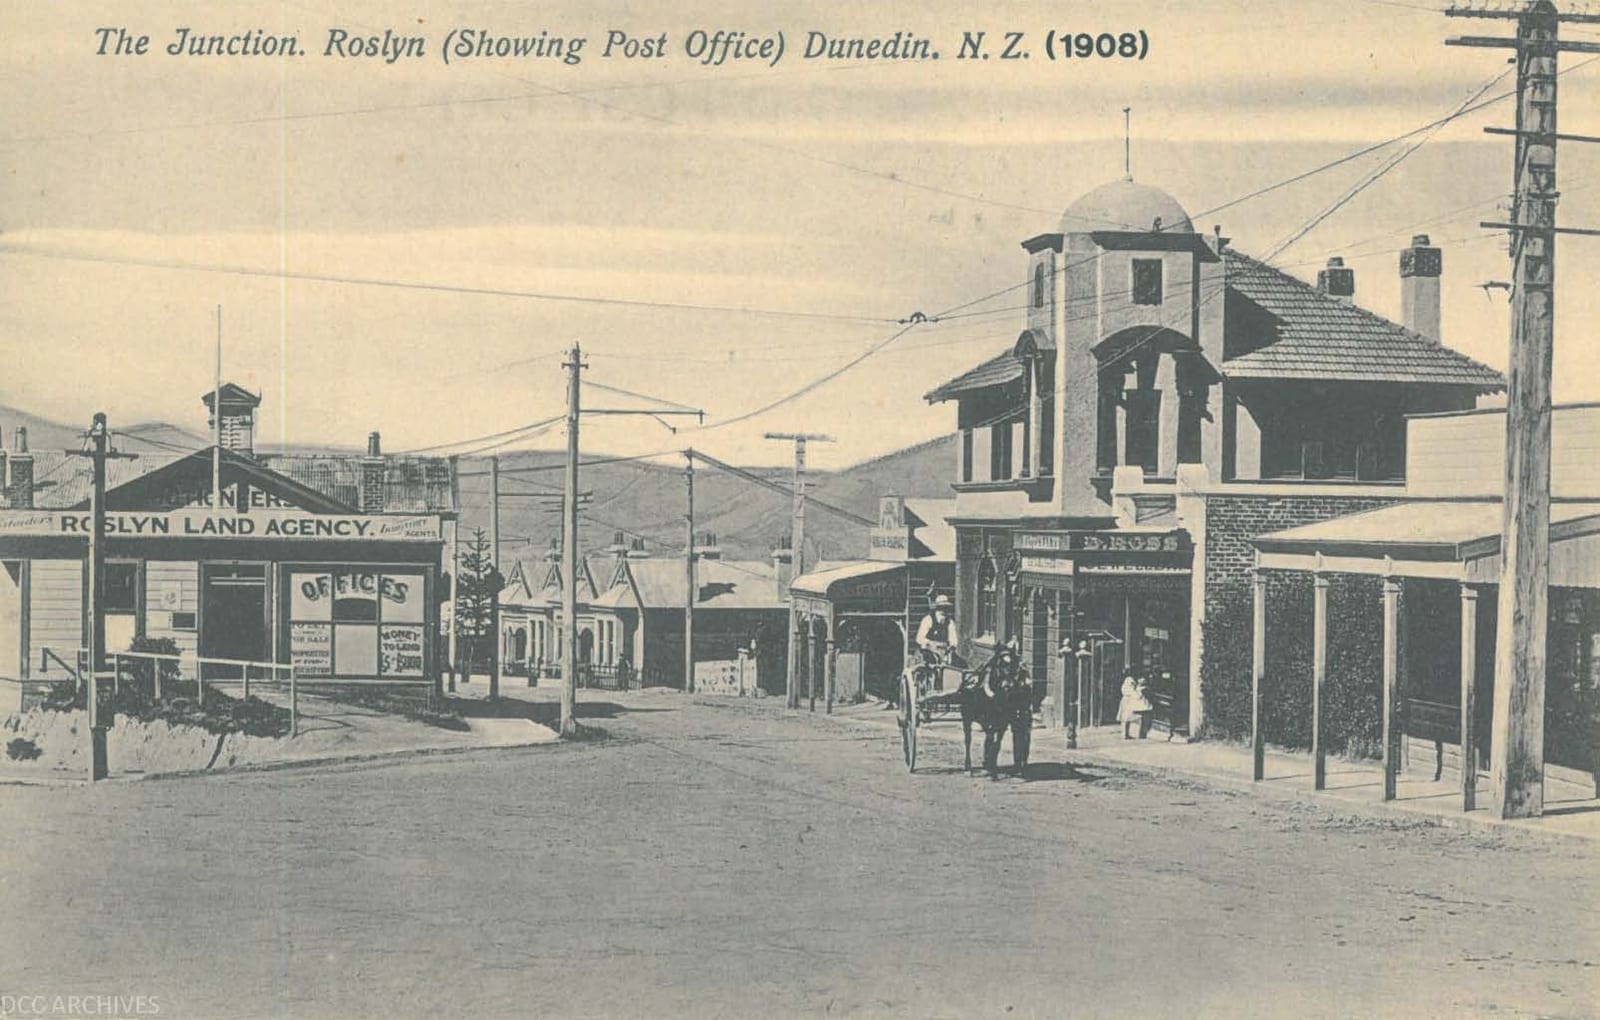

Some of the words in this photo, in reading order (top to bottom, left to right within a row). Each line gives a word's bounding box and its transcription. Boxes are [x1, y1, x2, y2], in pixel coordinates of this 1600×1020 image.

[184, 517, 255, 535] LAND
[265, 518, 376, 536] AGENCY.
[301, 574, 409, 604] OFFICES
[381, 630, 421, 641] MONEY
[382, 643, 396, 651] TO
